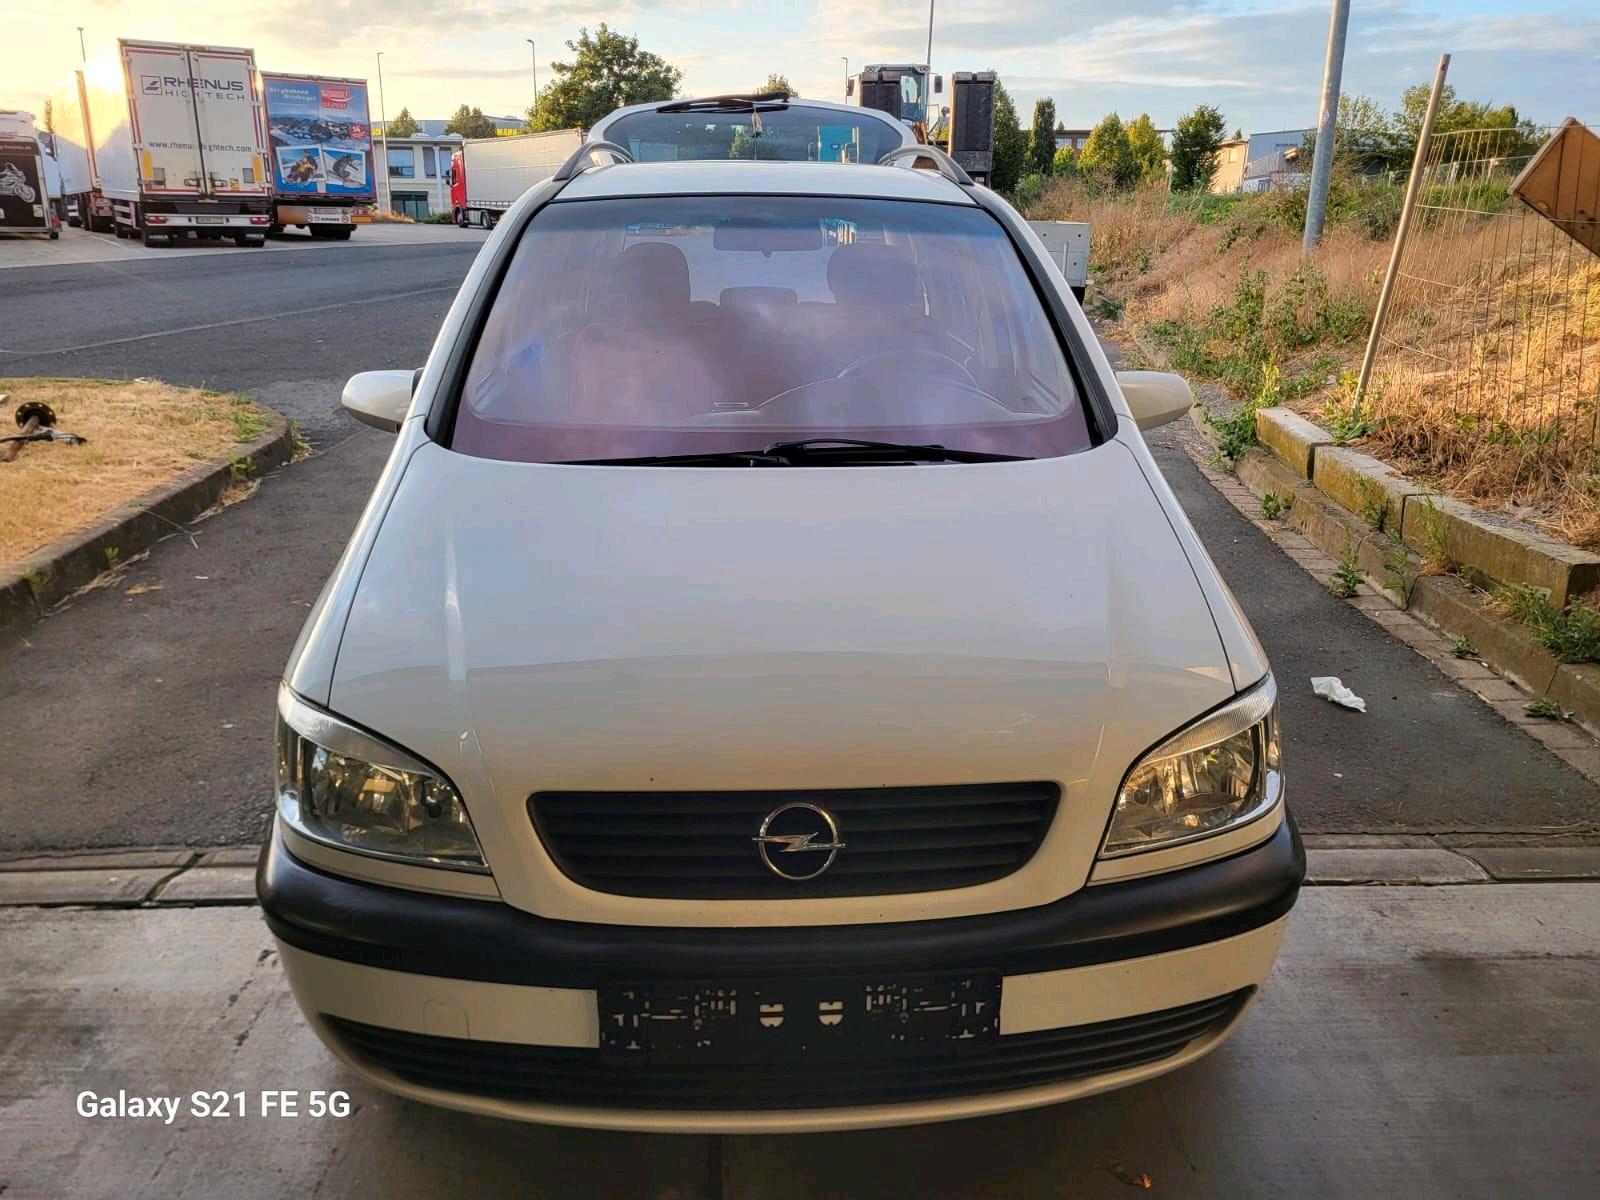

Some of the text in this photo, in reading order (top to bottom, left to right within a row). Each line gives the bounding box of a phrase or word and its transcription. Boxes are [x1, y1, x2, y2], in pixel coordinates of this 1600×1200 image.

[164, 77, 244, 91] RHENUS
[205, 92, 245, 101] TECH
[149, 141, 252, 152] www.rhenushightech.com
